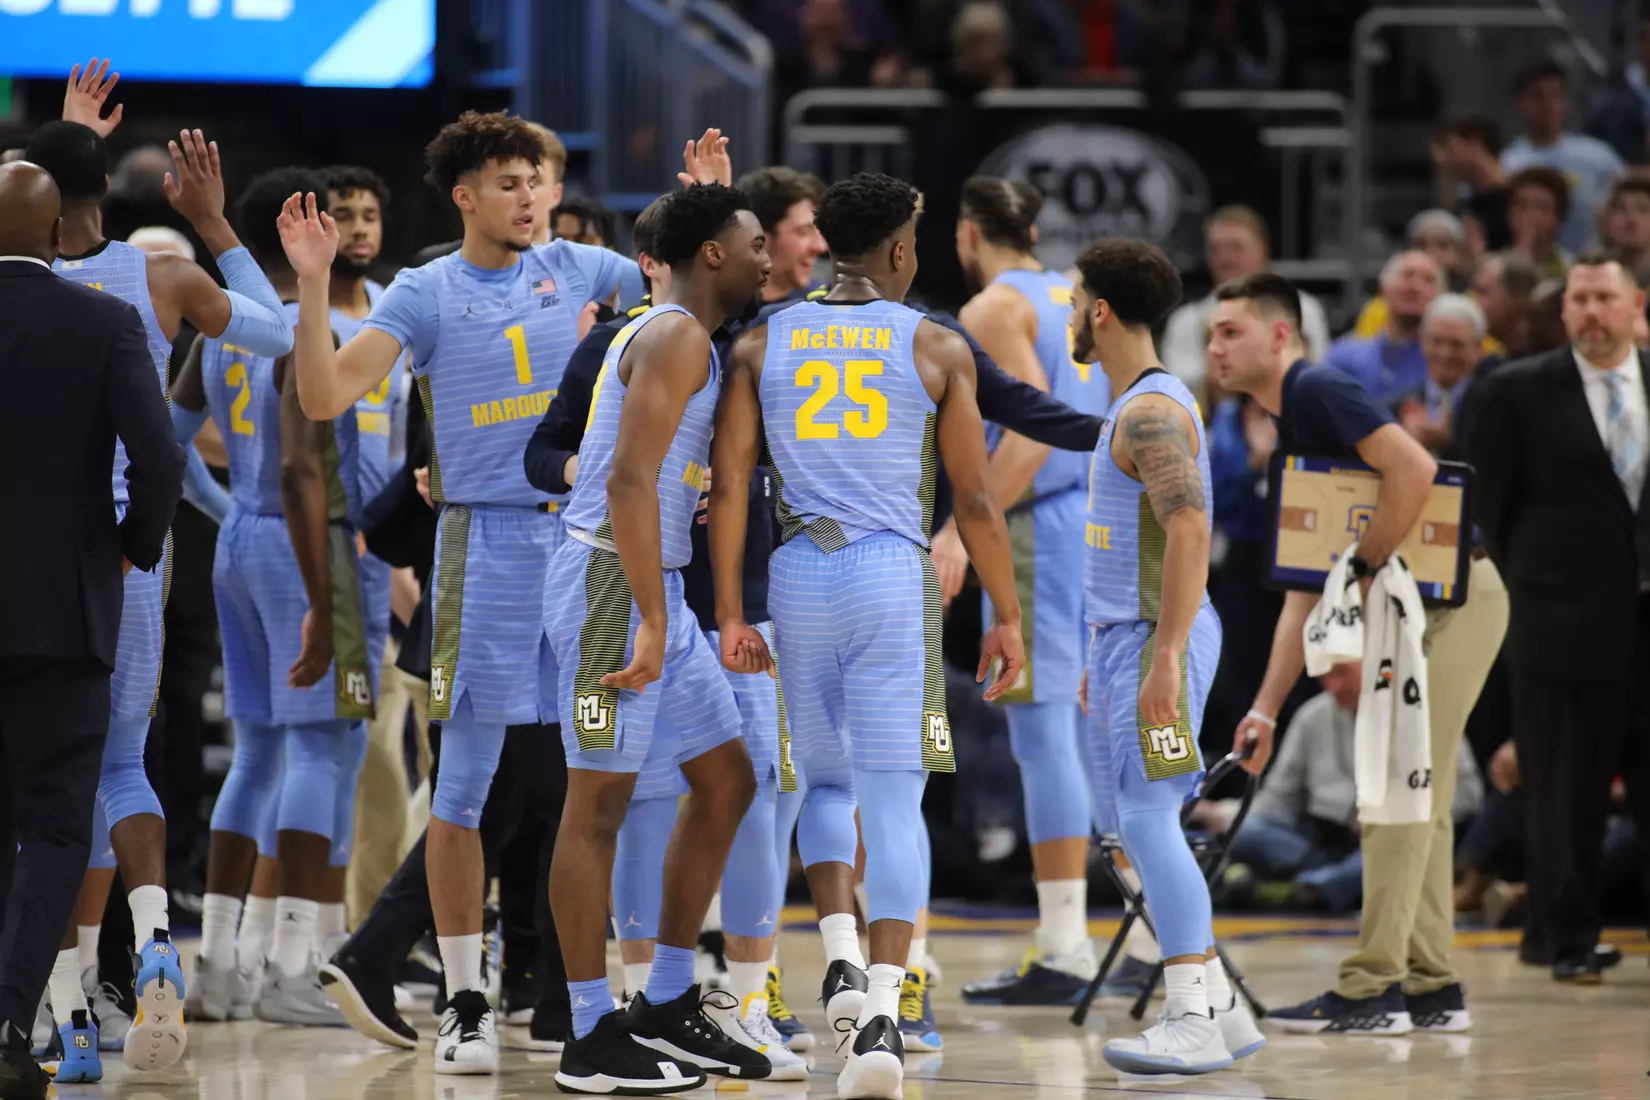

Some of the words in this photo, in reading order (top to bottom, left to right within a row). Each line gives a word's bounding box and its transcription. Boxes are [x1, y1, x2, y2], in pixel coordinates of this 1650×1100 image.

[504, 324, 532, 385] 1
[791, 325, 891, 351] McEWEN
[225, 362, 255, 436] 2
[471, 390, 558, 428] MARQUE
[795, 360, 888, 440] 25
[576, 693, 611, 732] MU
[928, 713, 951, 753] MU
[1147, 725, 1190, 762] MU
